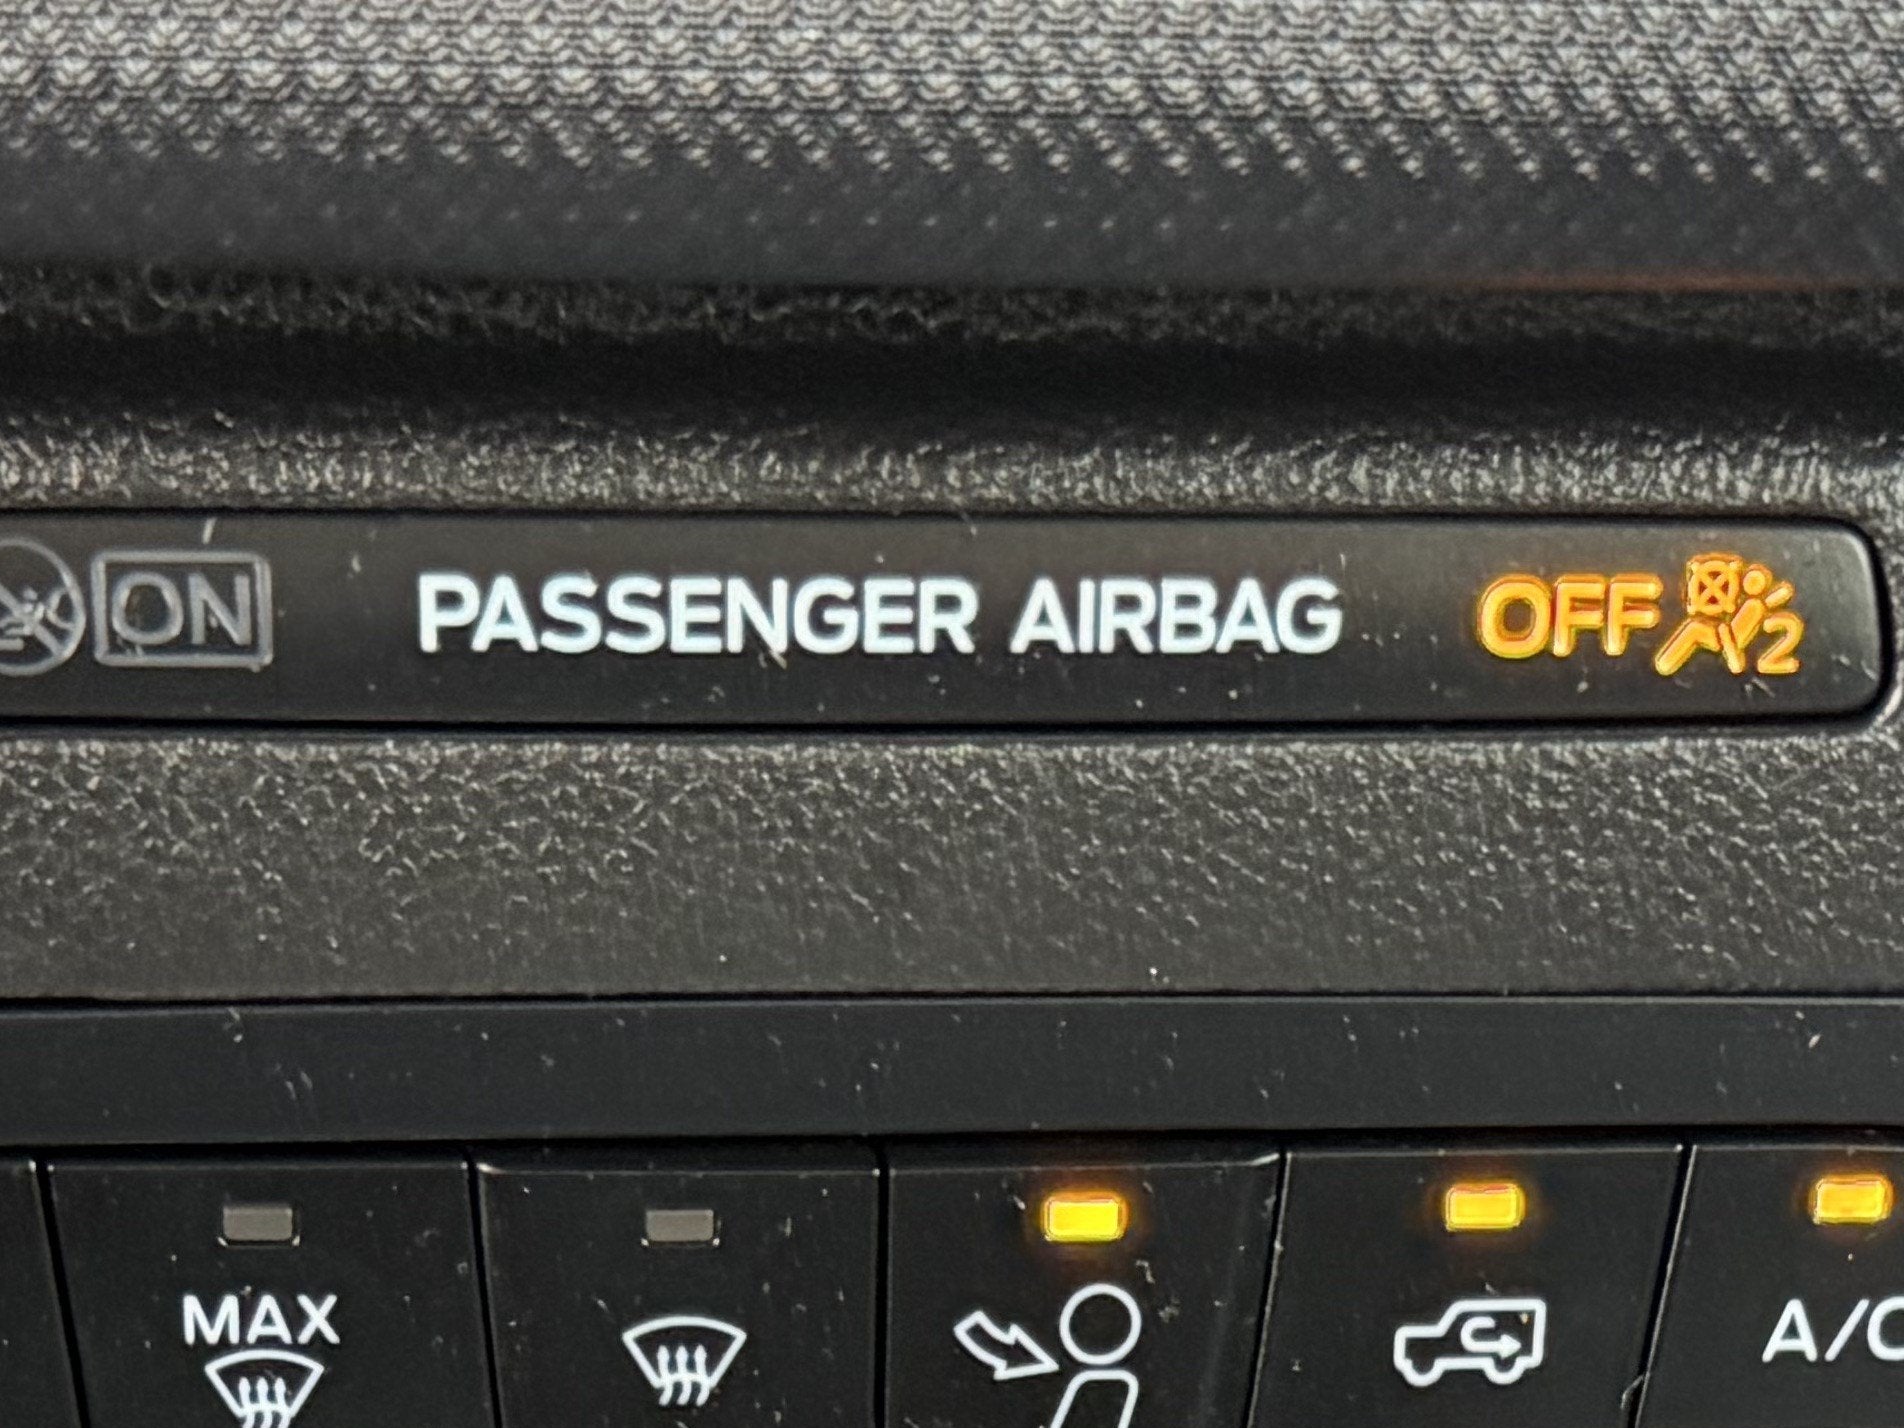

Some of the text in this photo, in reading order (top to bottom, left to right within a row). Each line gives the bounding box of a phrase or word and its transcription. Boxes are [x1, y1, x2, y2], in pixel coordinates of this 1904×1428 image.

[111, 570, 251, 647] ON
[417, 573, 1344, 655] PASSENGER AIRBAG
[1478, 573, 1663, 659] OFF
[182, 1294, 340, 1346] MAX
